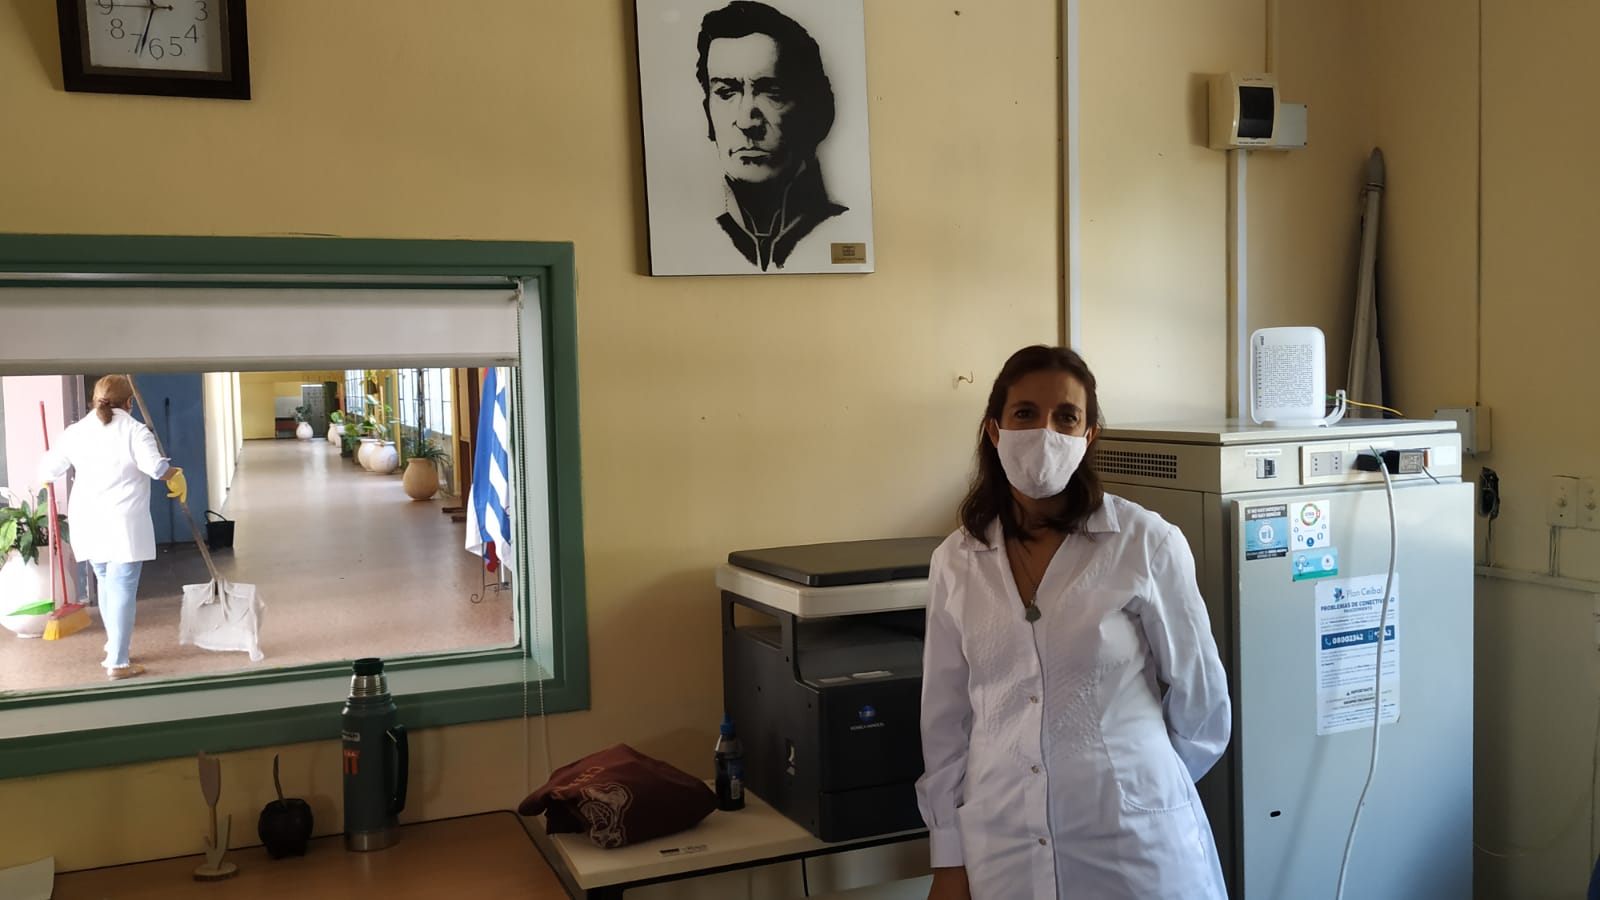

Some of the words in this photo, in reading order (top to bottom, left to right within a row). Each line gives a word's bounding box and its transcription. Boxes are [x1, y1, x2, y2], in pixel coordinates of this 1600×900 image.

[98, 0, 114, 16] 9
[194, 1, 208, 21] 3
[110, 18, 125, 40] 8
[184, 23, 200, 44] 4
[129, 33, 143, 54] 7
[149, 37, 164, 60] 6
[169, 36, 183, 57] 5
[1361, 586, 1384, 597] Ceibal
[1320, 603, 1351, 611] PROBLEMAS
